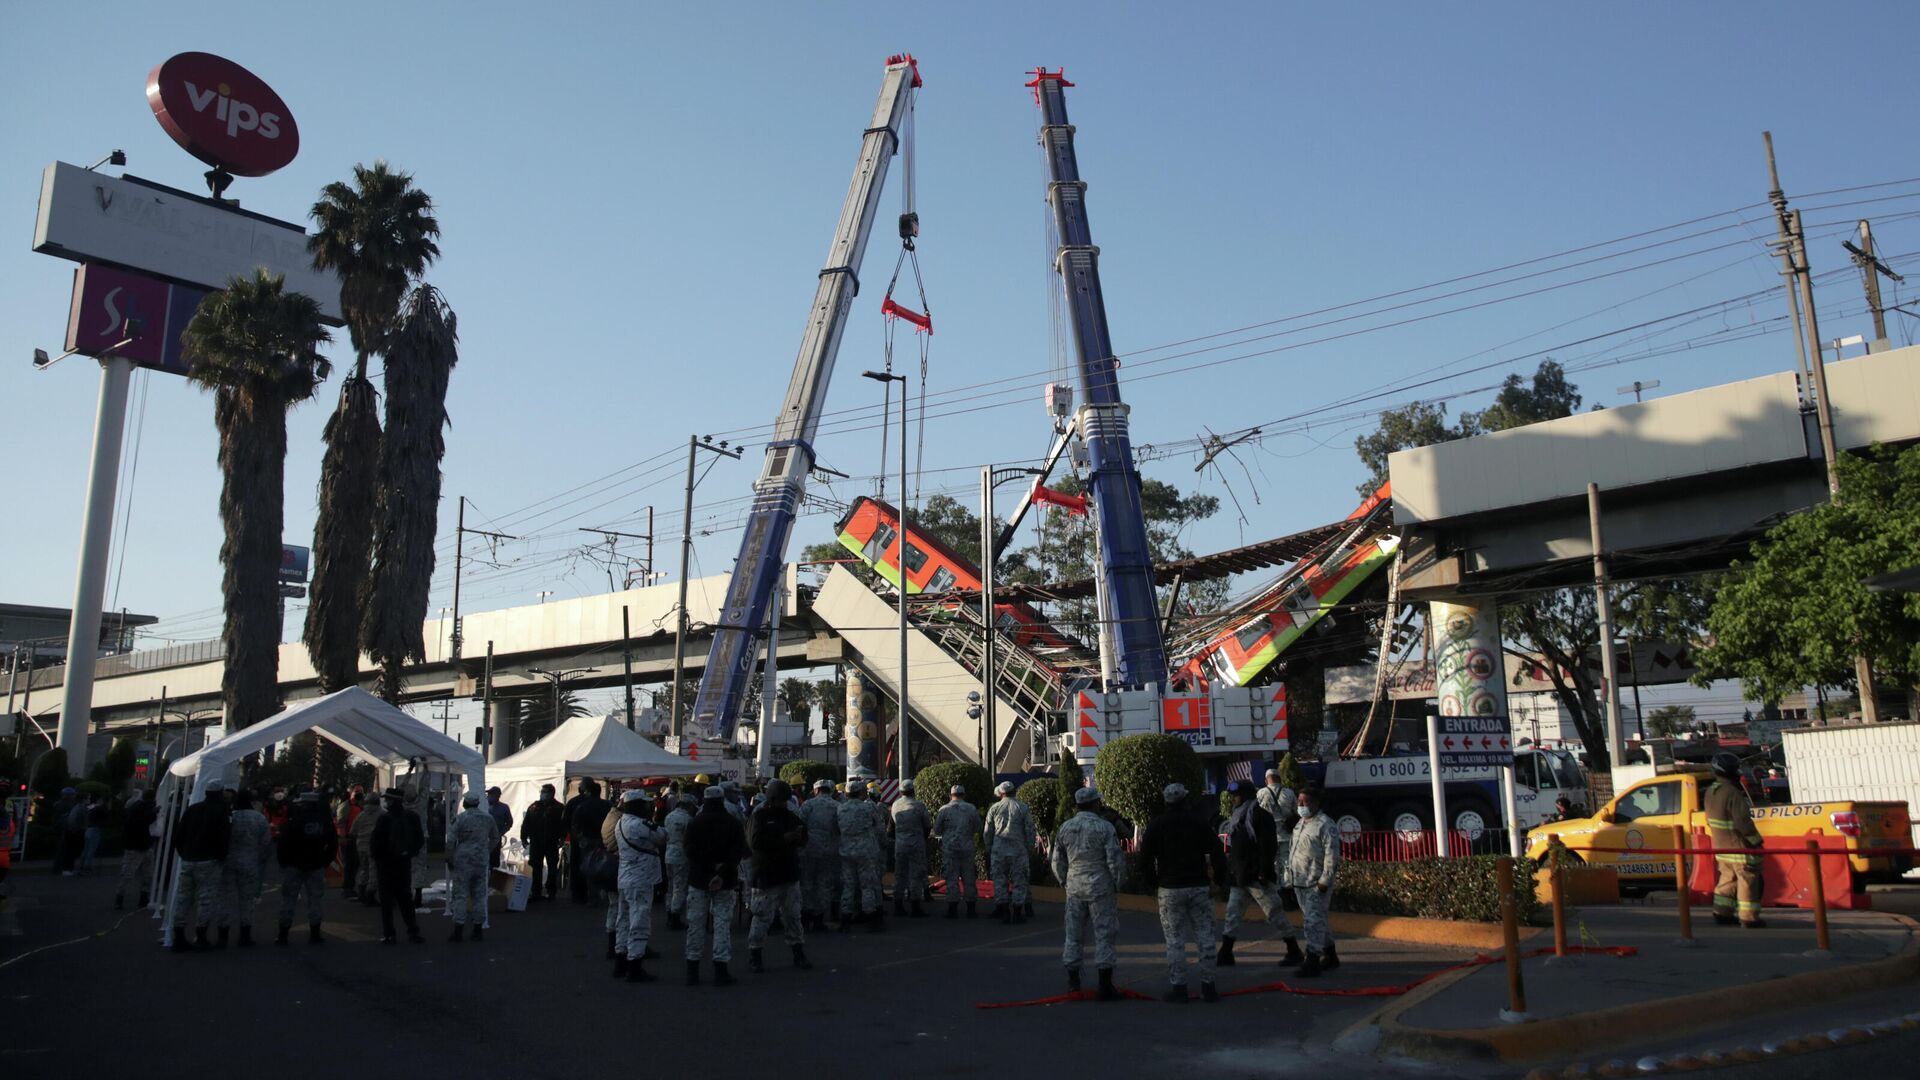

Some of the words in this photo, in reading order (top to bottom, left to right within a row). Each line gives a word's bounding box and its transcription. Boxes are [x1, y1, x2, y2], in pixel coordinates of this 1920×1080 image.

[184, 80, 280, 139] vips
[1177, 701, 1190, 726] 1
[1445, 718, 1504, 732] ENTRADA
[1369, 764, 1385, 777] 01
[1390, 762, 1416, 776] 800
[1516, 794, 1537, 803] argo
[1769, 805, 1823, 818] PILOTO
